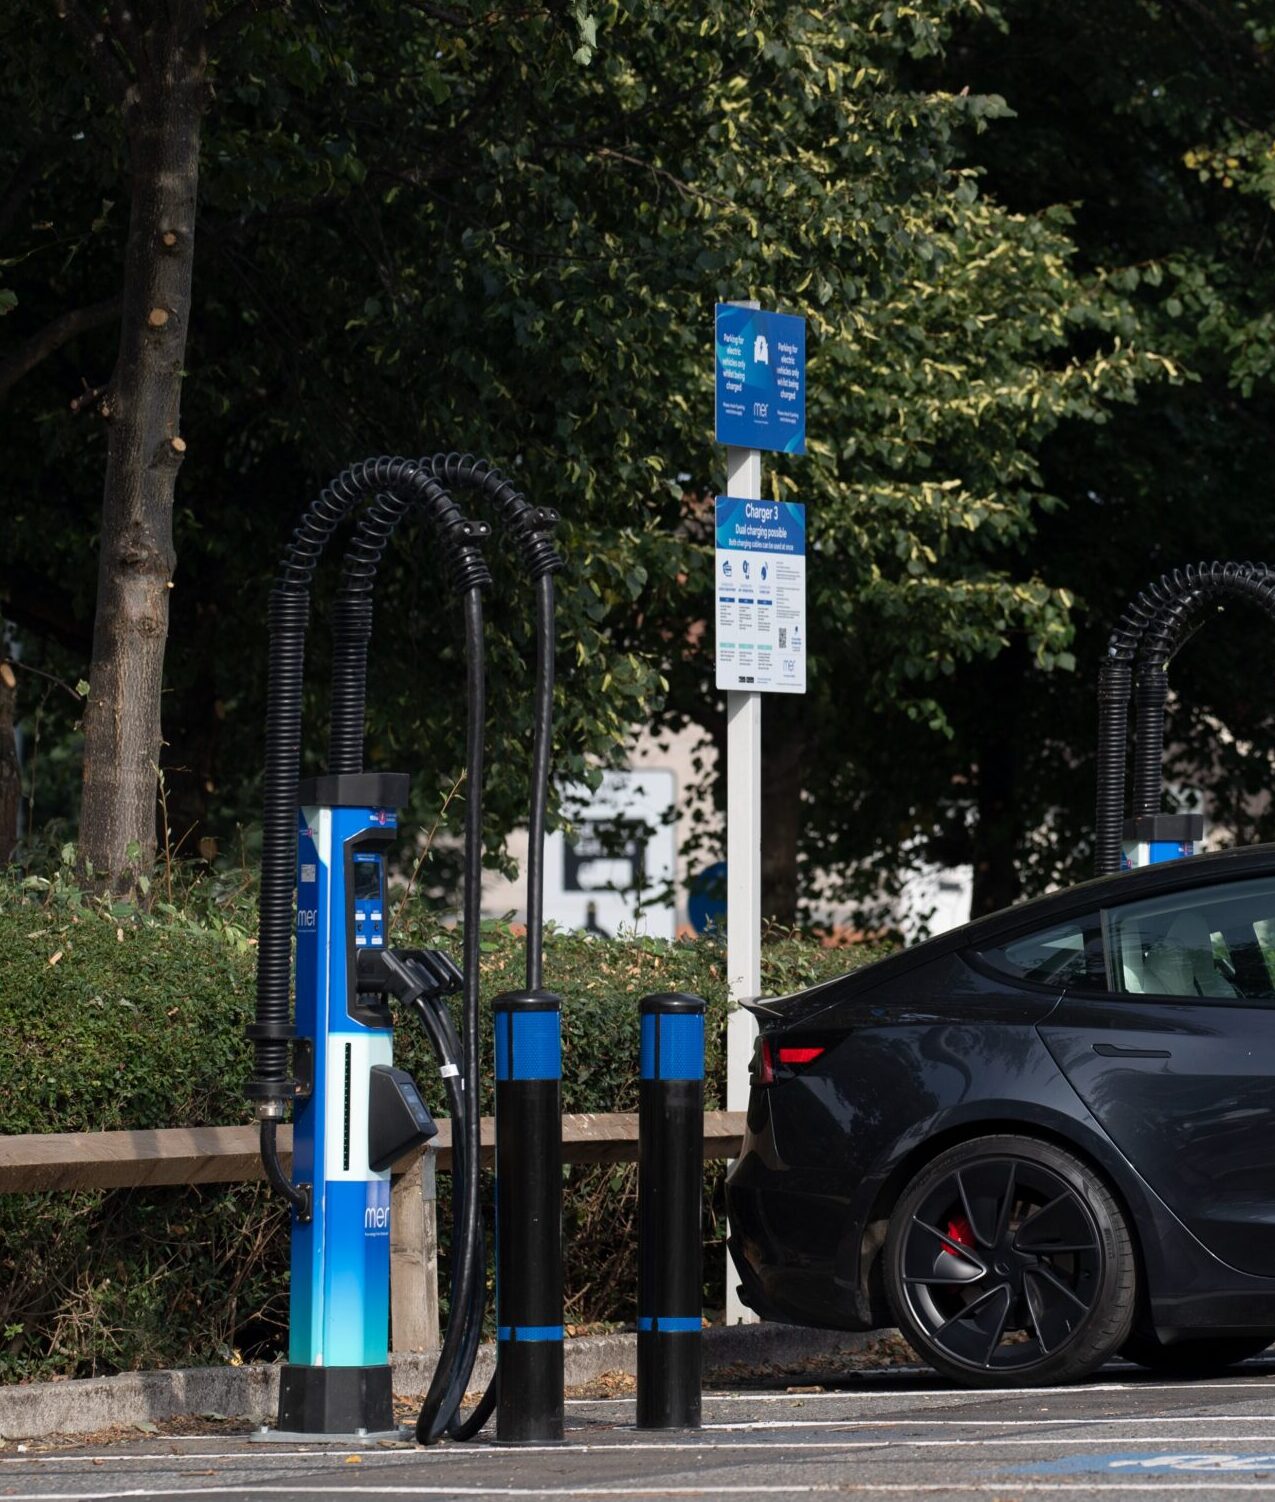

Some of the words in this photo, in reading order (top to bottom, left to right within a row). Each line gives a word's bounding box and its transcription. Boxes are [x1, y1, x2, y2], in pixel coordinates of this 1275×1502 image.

[754, 402, 768, 417] mer
[745, 502, 773, 523] Charger
[773, 505, 779, 520] 3
[735, 523, 746, 535] Dual
[747, 524, 767, 539] charging
[767, 526, 787, 539] possible
[297, 909, 317, 926] mer
[364, 1207, 390, 1228] mer
